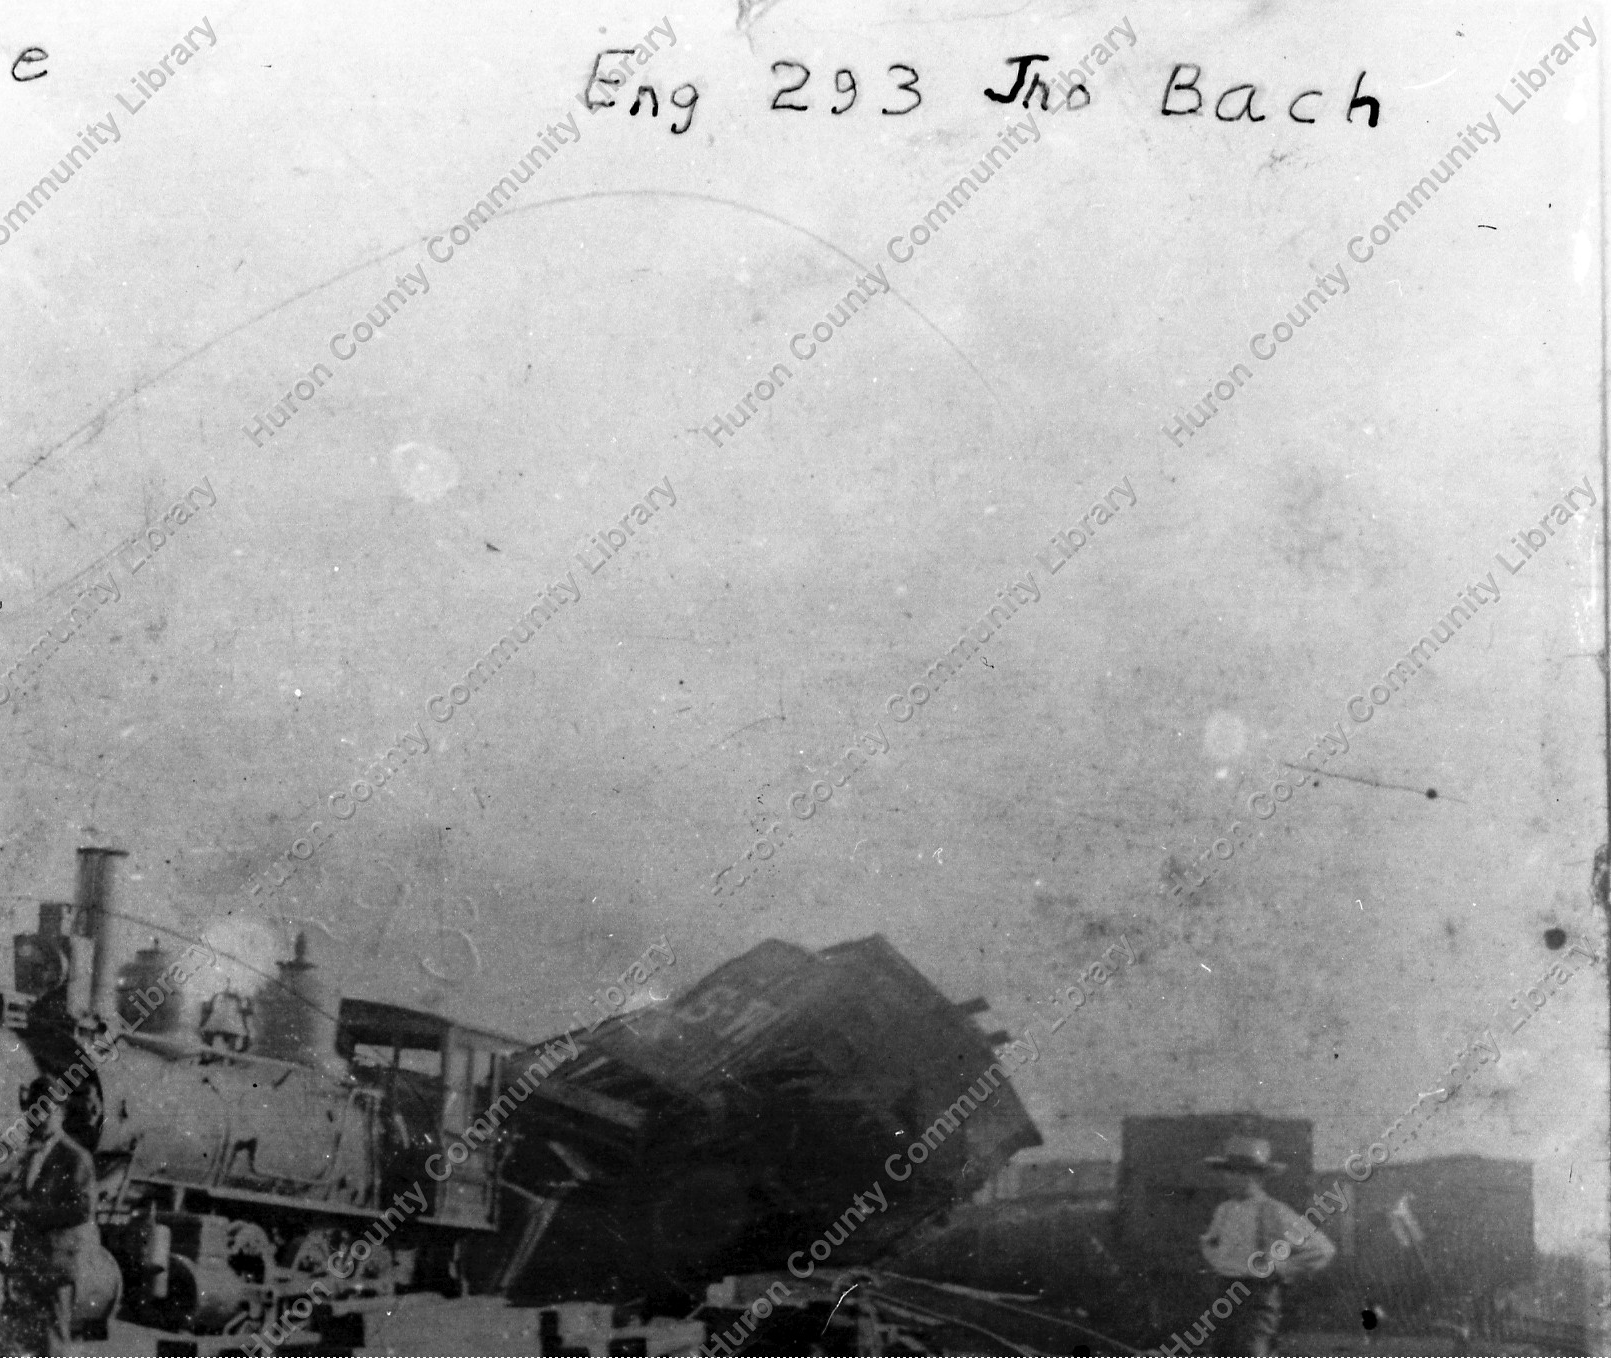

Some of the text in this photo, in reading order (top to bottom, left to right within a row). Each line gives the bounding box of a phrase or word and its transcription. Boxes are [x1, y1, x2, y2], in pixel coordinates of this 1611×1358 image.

[585, 48, 699, 134] Eng
[771, 61, 923, 115] 293
[1161, 63, 1381, 128] Bach
